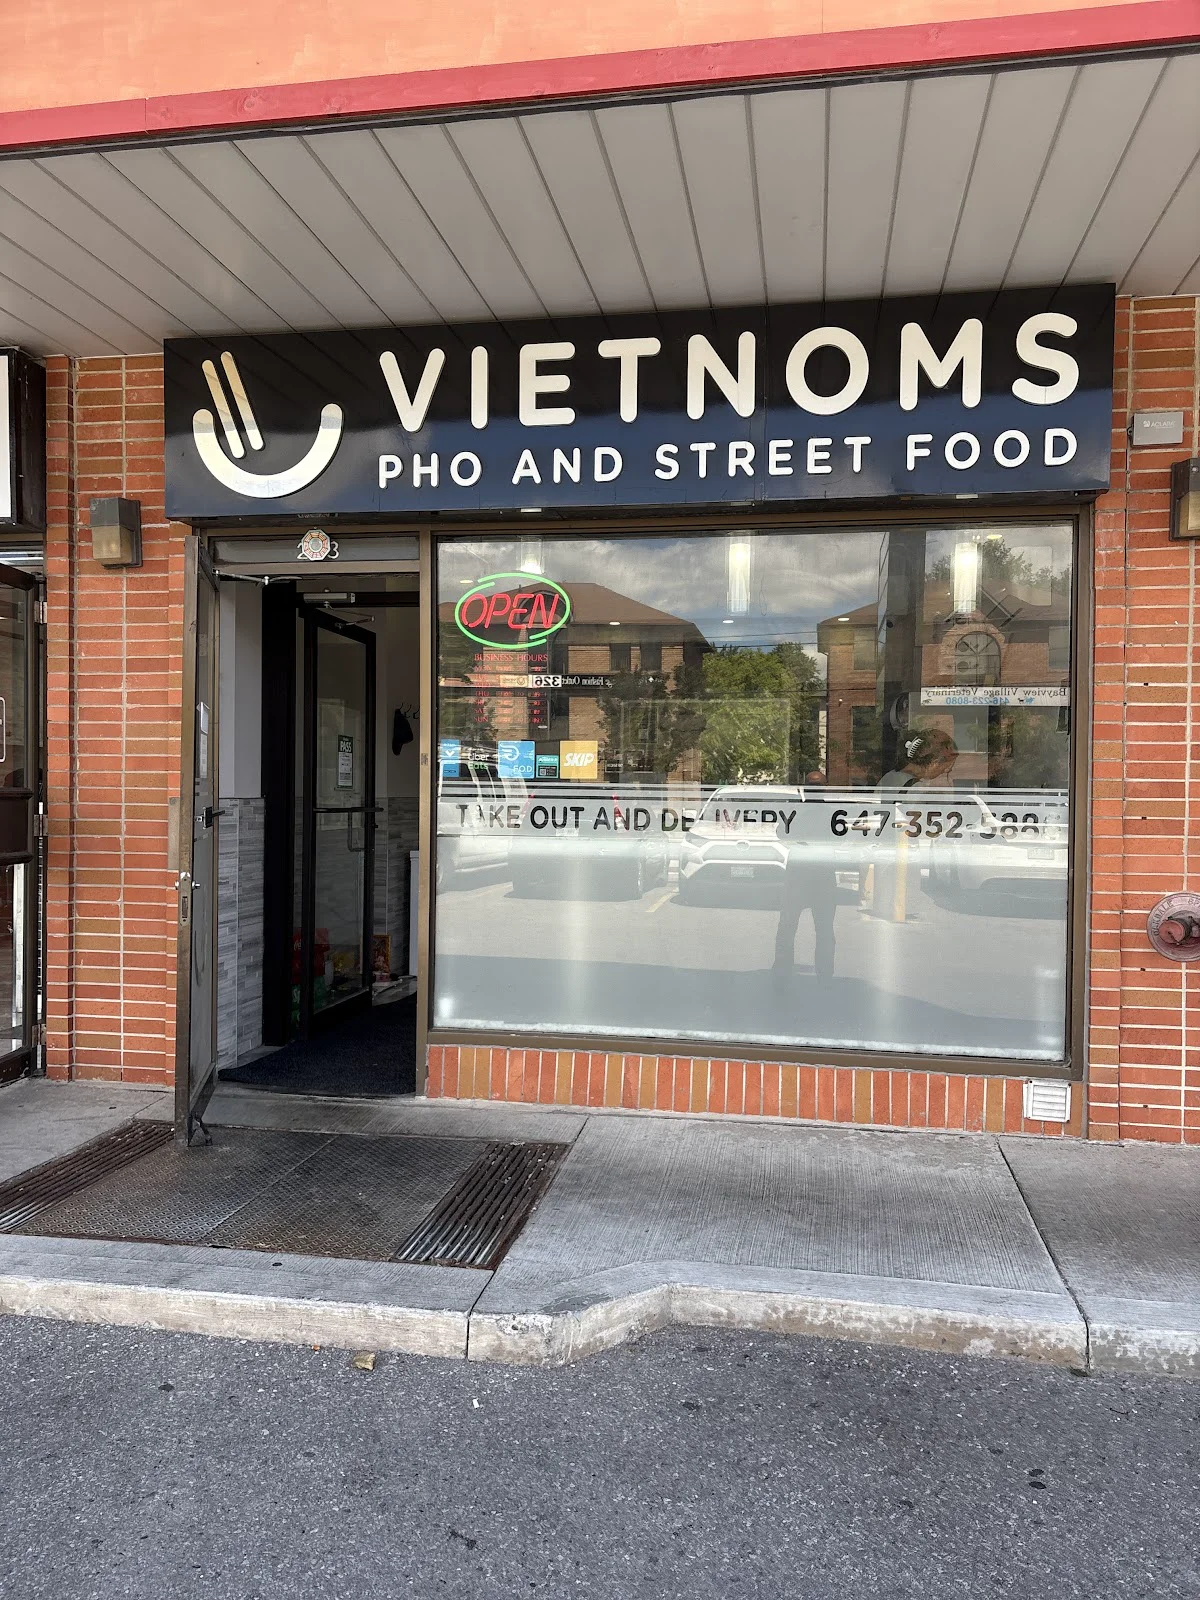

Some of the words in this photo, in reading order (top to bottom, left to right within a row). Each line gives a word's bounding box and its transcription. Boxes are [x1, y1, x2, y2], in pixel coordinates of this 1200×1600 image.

[379, 312, 1079, 433] VIETNOMS
[378, 451, 483, 489] PHO
[511, 447, 623, 485] AND
[654, 435, 872, 481] STREET
[906, 427, 1078, 471] FOOD
[461, 594, 559, 629] OPEN
[474, 653, 514, 662] BUSINESS
[517, 653, 548, 662] HOURS
[467, 761, 489, 770] Eats
[563, 752, 594, 767] SKIP
[455, 804, 521, 829] TAKE
[530, 804, 585, 830] OUT
[593, 805, 651, 831] AND
